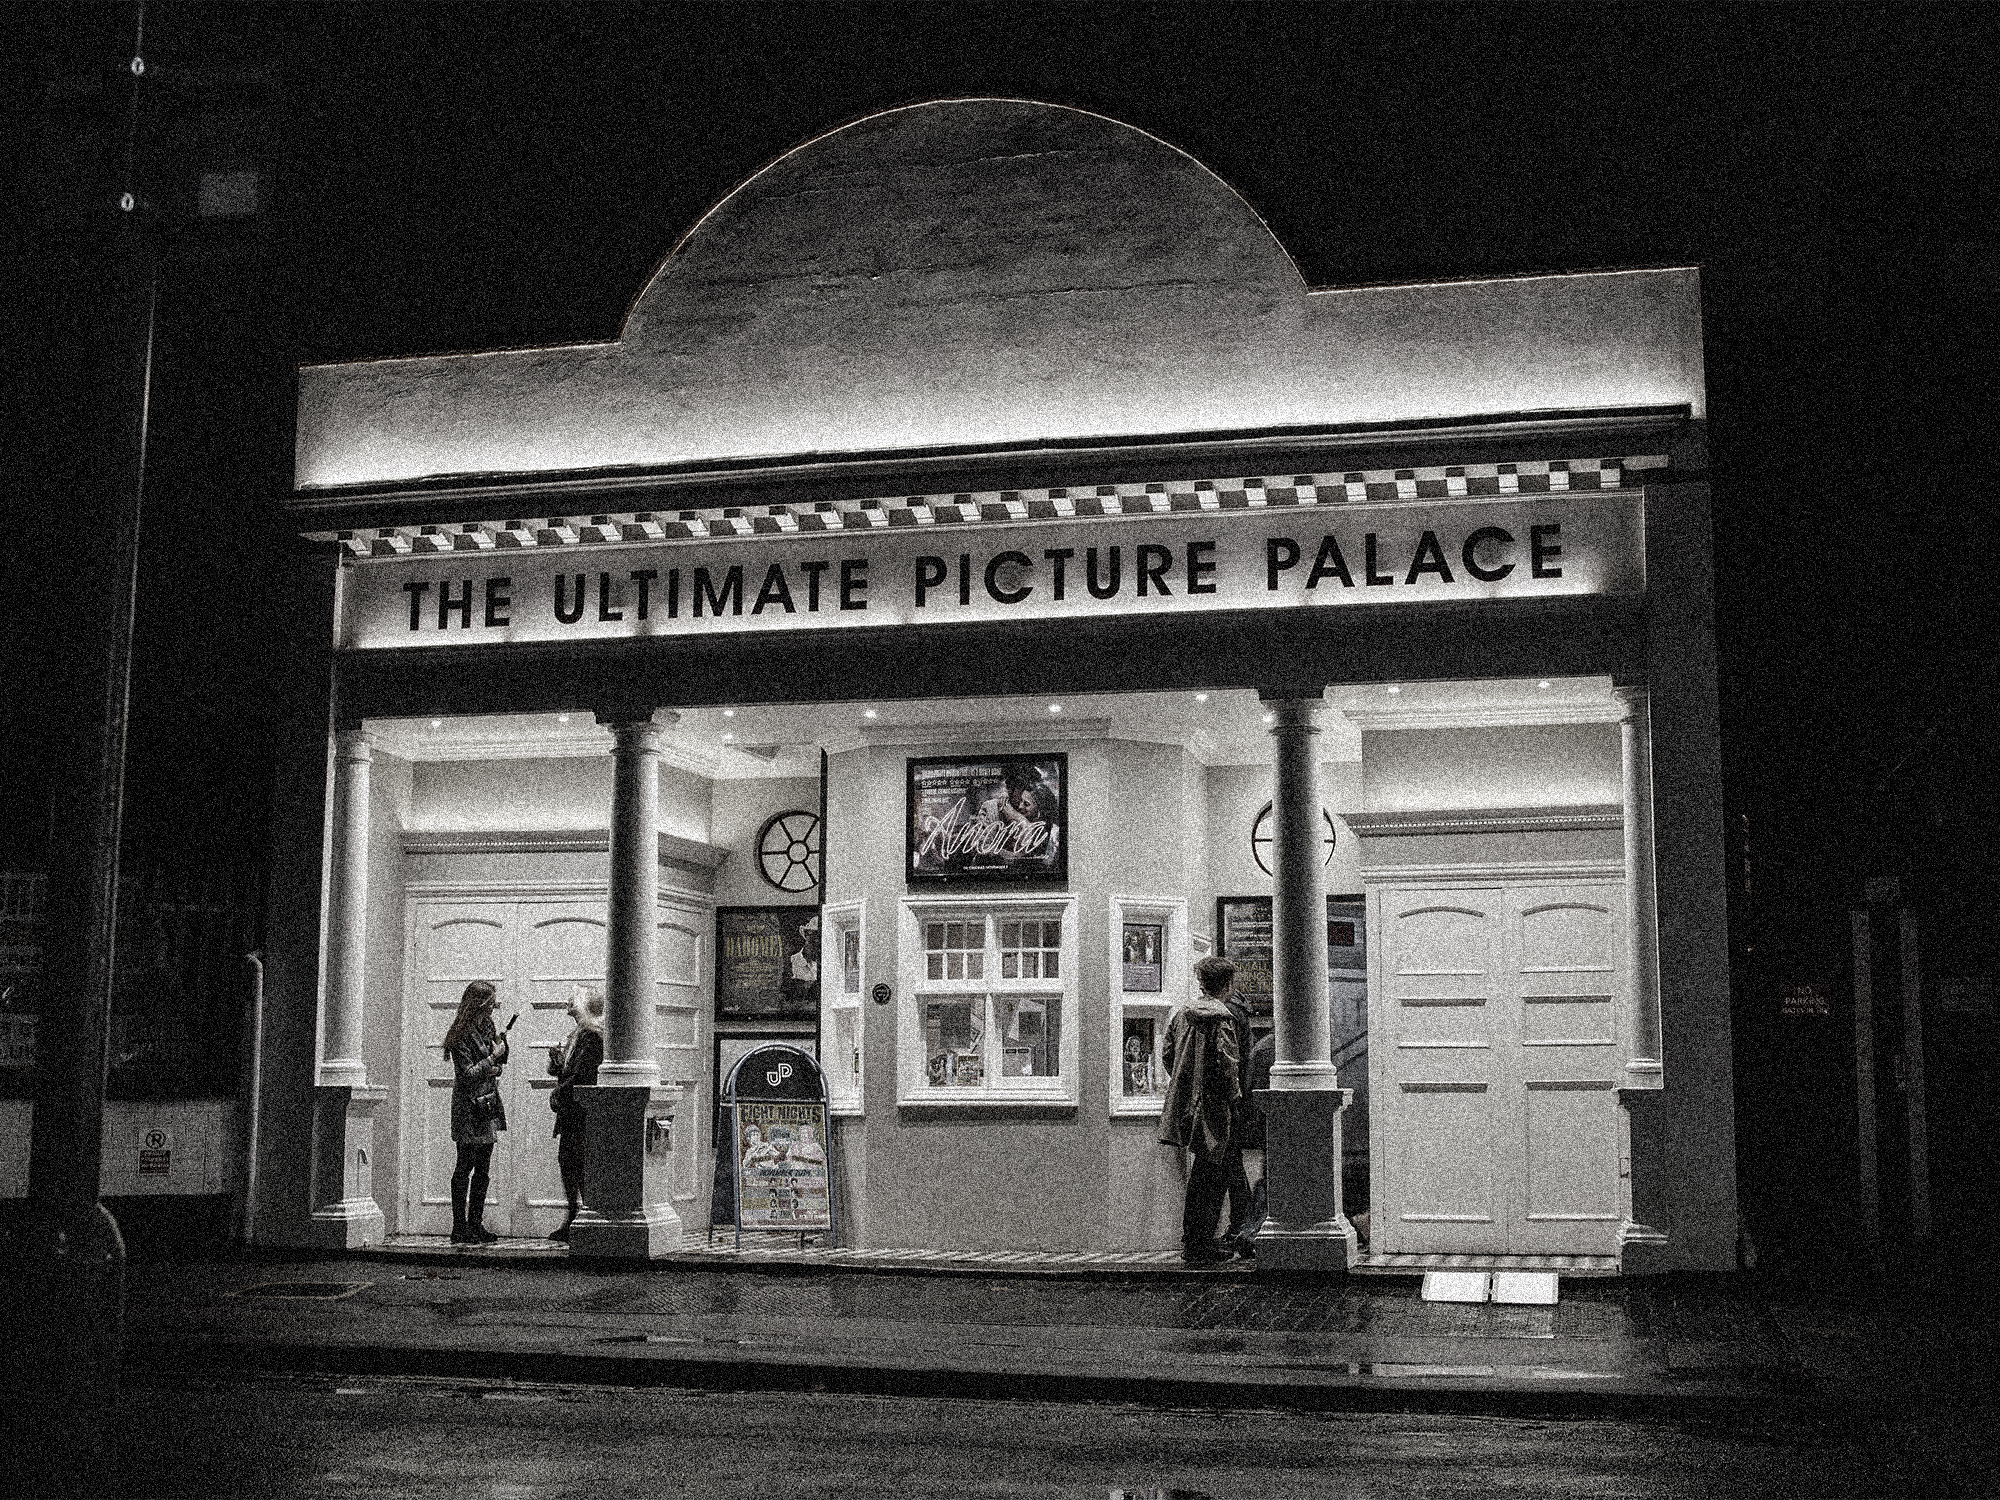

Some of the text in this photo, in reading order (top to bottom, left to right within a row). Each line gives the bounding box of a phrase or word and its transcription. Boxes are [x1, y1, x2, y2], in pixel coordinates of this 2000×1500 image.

[403, 523, 1564, 631] THE ULTIMATE PICTURE PALACE
[920, 796, 1049, 860] Anora
[725, 935, 785, 957] DAHOMEY
[1233, 961, 1269, 972] SMALL
[1797, 986, 1812, 995] NO
[1785, 997, 1825, 1005] PARKING
[740, 1104, 822, 1124] FIGHT NIGHTS
